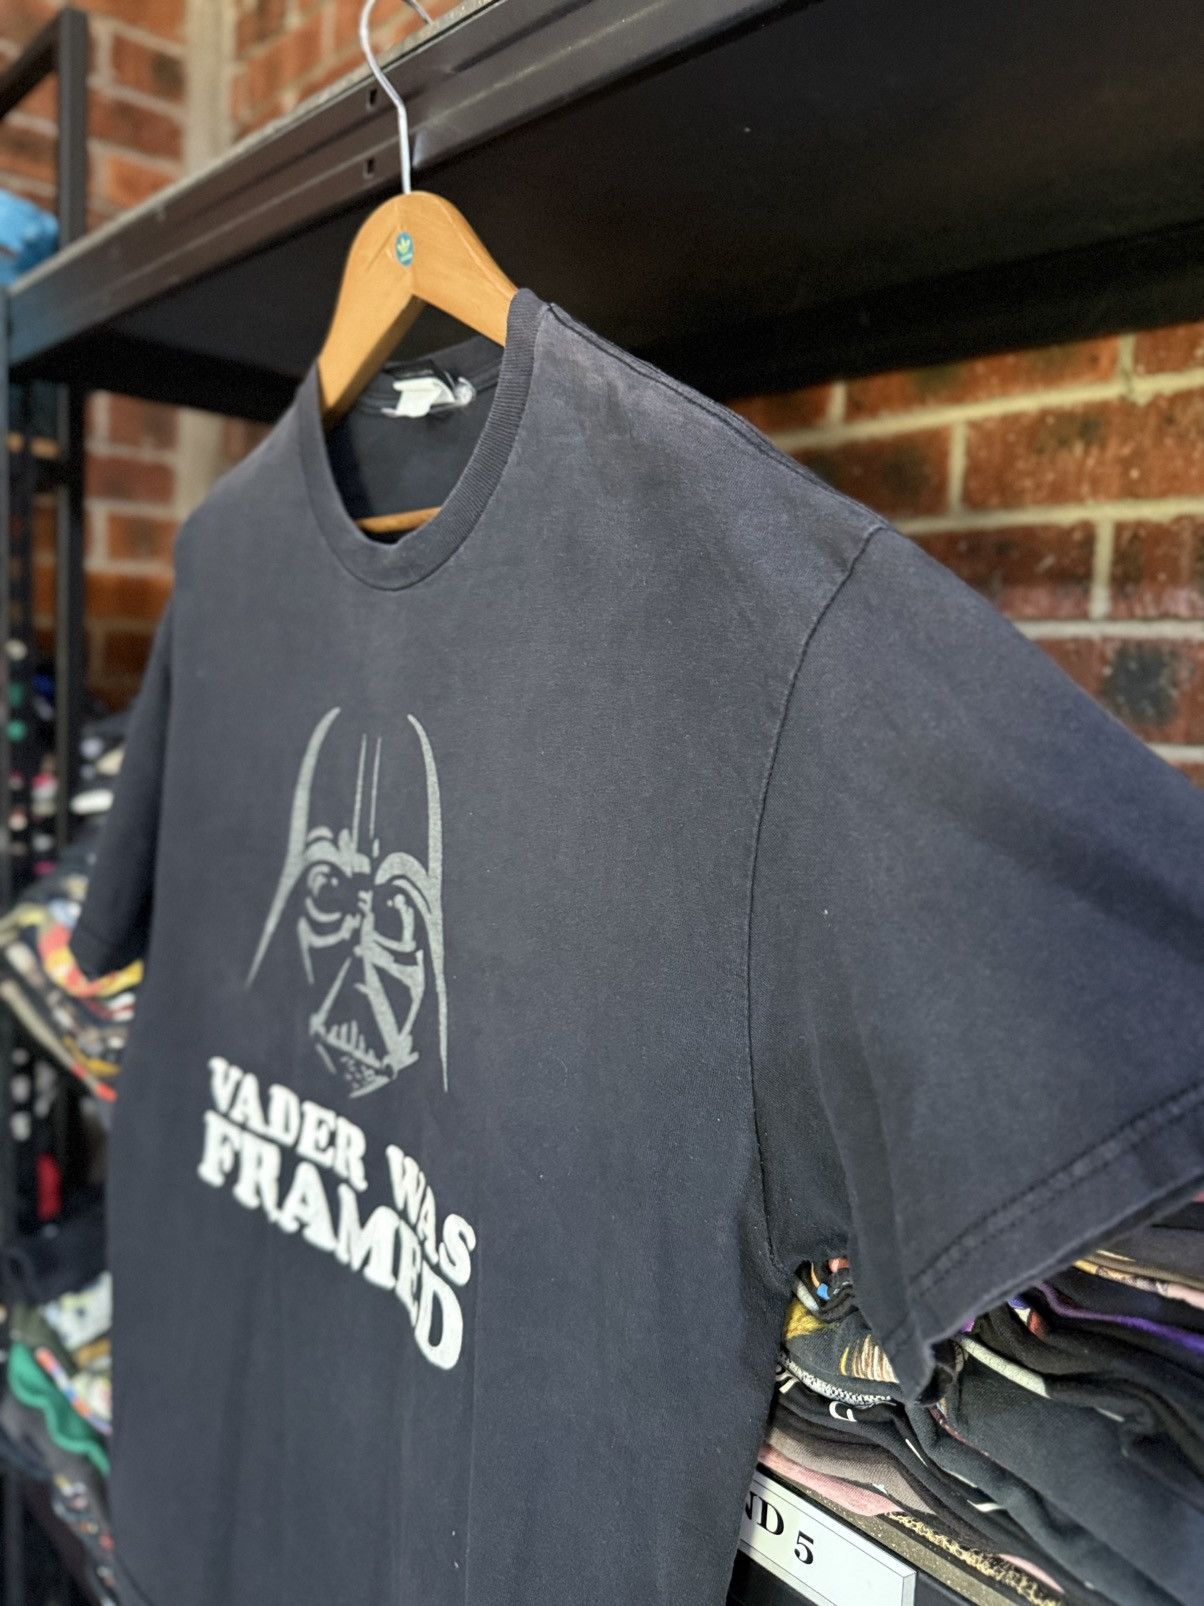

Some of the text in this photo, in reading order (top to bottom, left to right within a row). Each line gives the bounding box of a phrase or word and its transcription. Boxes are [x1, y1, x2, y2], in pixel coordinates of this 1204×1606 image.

[197, 1110, 463, 1370] FRAMED
[208, 1056, 476, 1287] VADER WAS
[794, 1530, 814, 1565] 5
